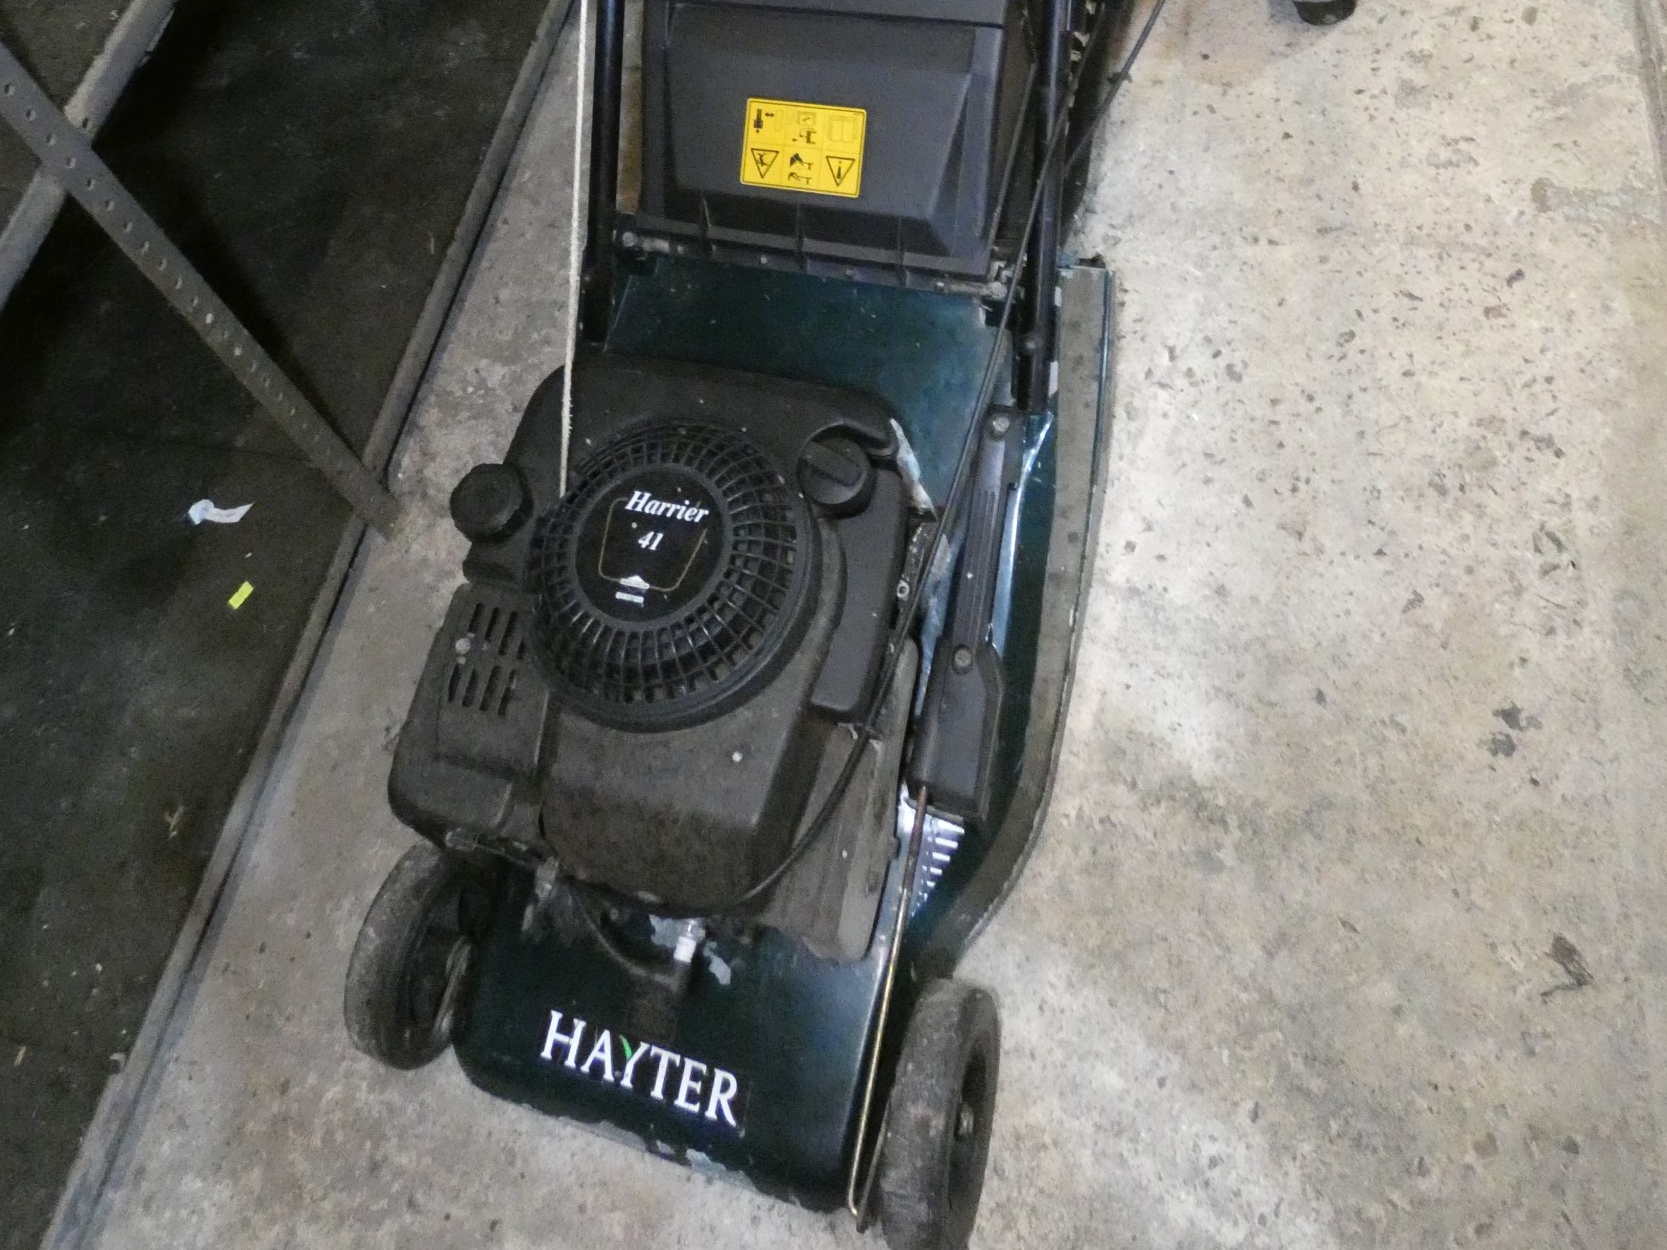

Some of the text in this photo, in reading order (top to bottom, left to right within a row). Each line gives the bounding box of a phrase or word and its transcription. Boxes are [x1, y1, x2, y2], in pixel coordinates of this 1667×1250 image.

[625, 490, 709, 523] Harrier
[638, 531, 664, 551] 41
[540, 1009, 738, 1128] HAYTER
